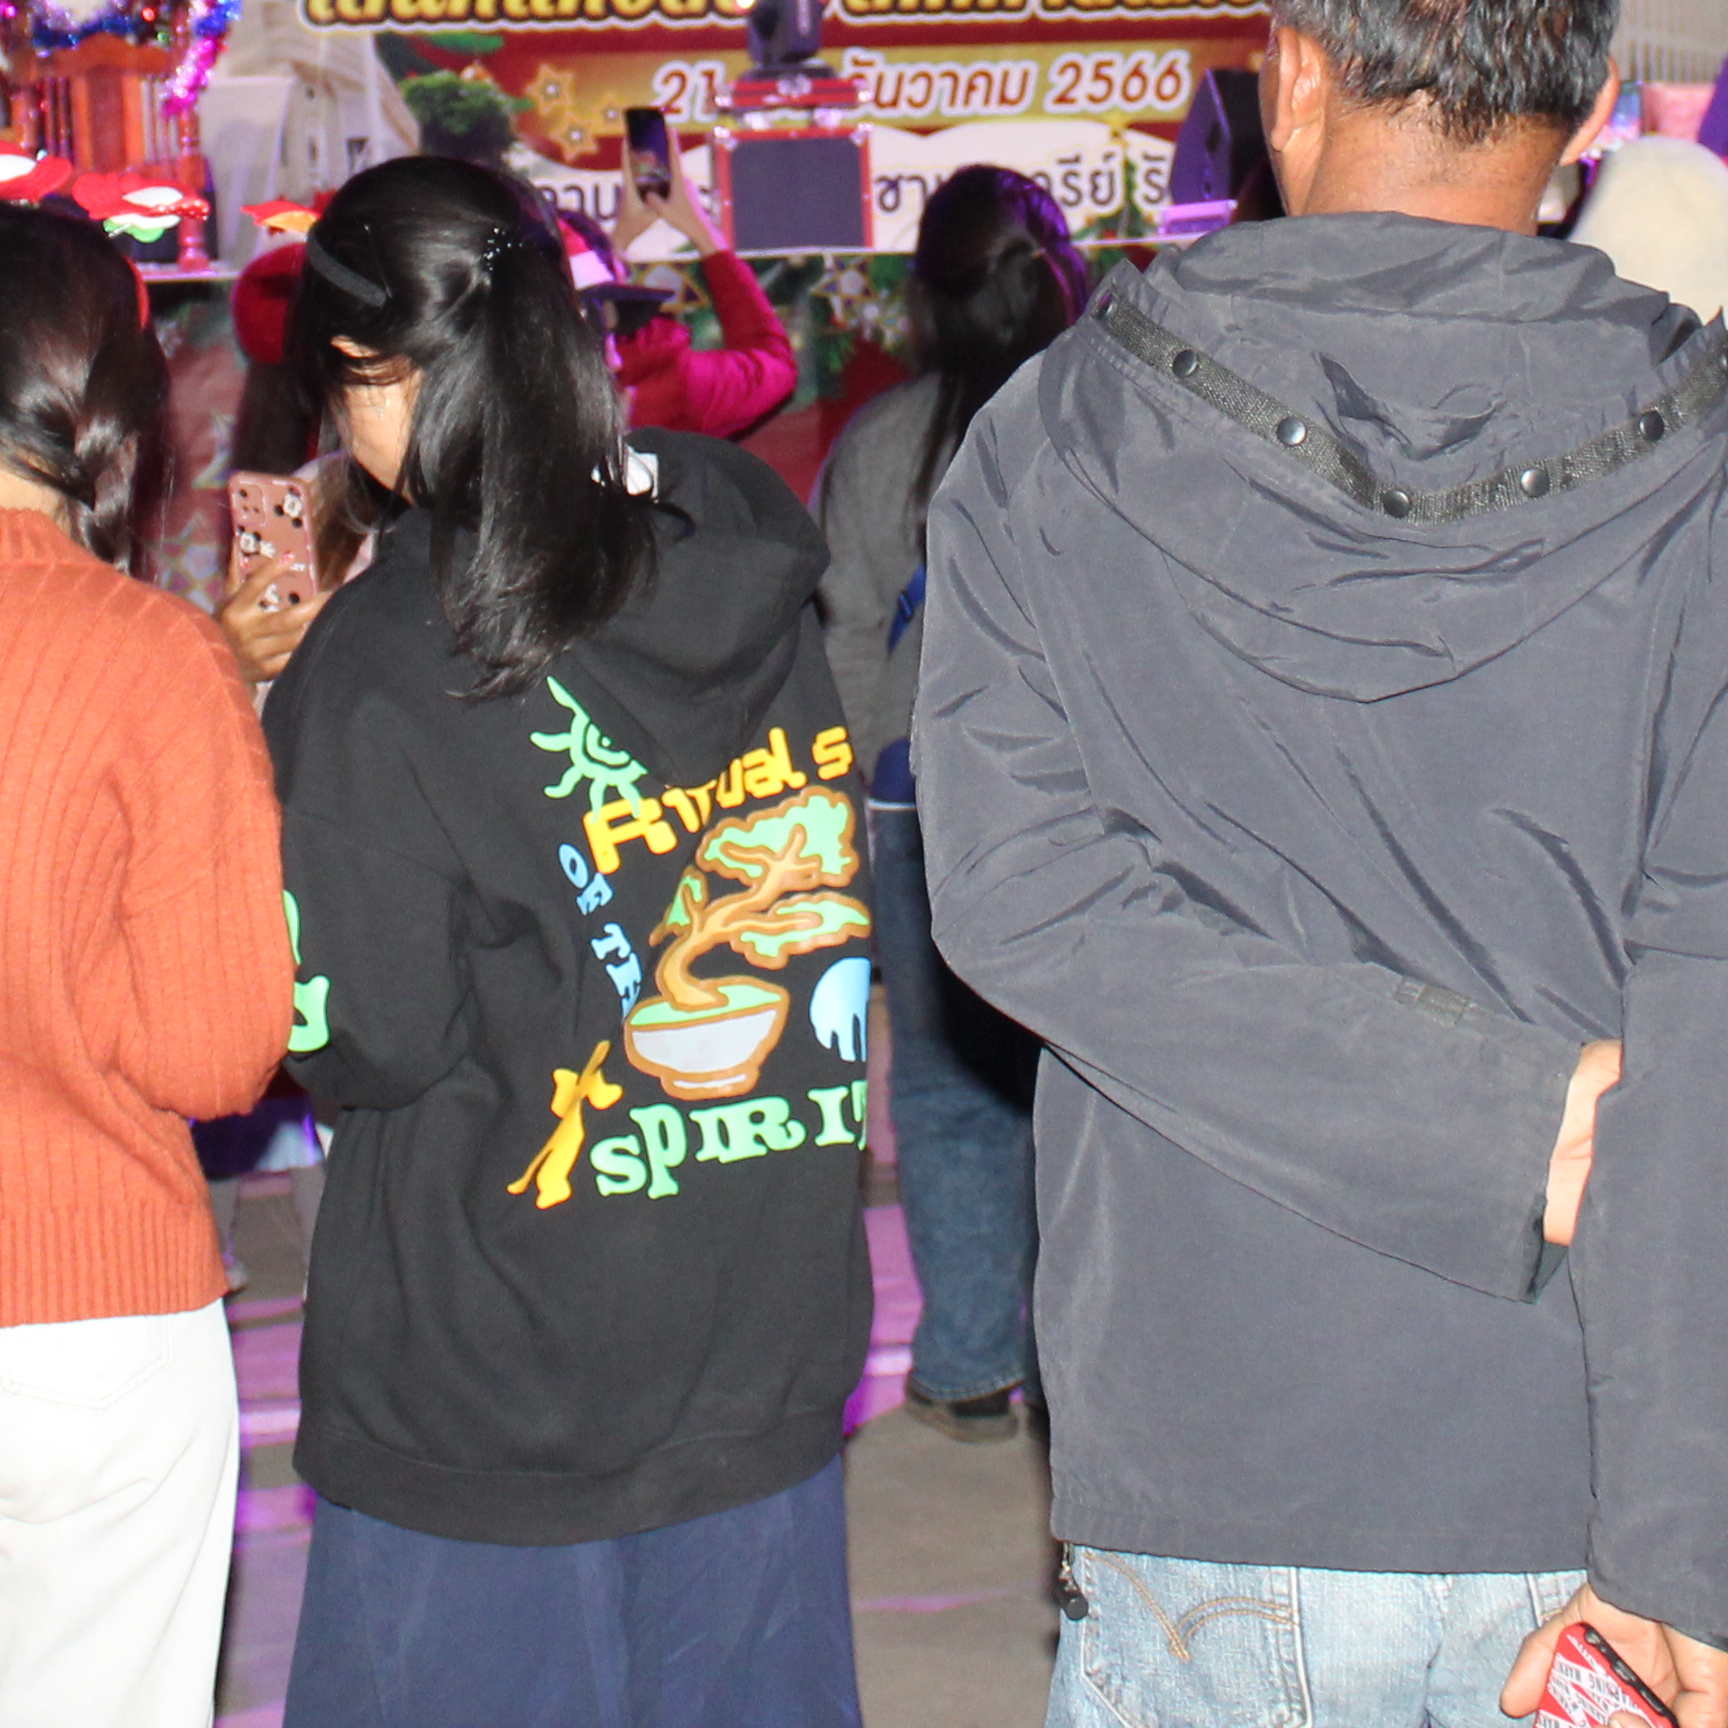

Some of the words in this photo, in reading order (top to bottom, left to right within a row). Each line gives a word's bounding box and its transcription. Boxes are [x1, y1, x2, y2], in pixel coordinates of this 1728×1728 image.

[848, 56, 1032, 112] ันวาคม
[1050, 56, 1186, 108] 2566
